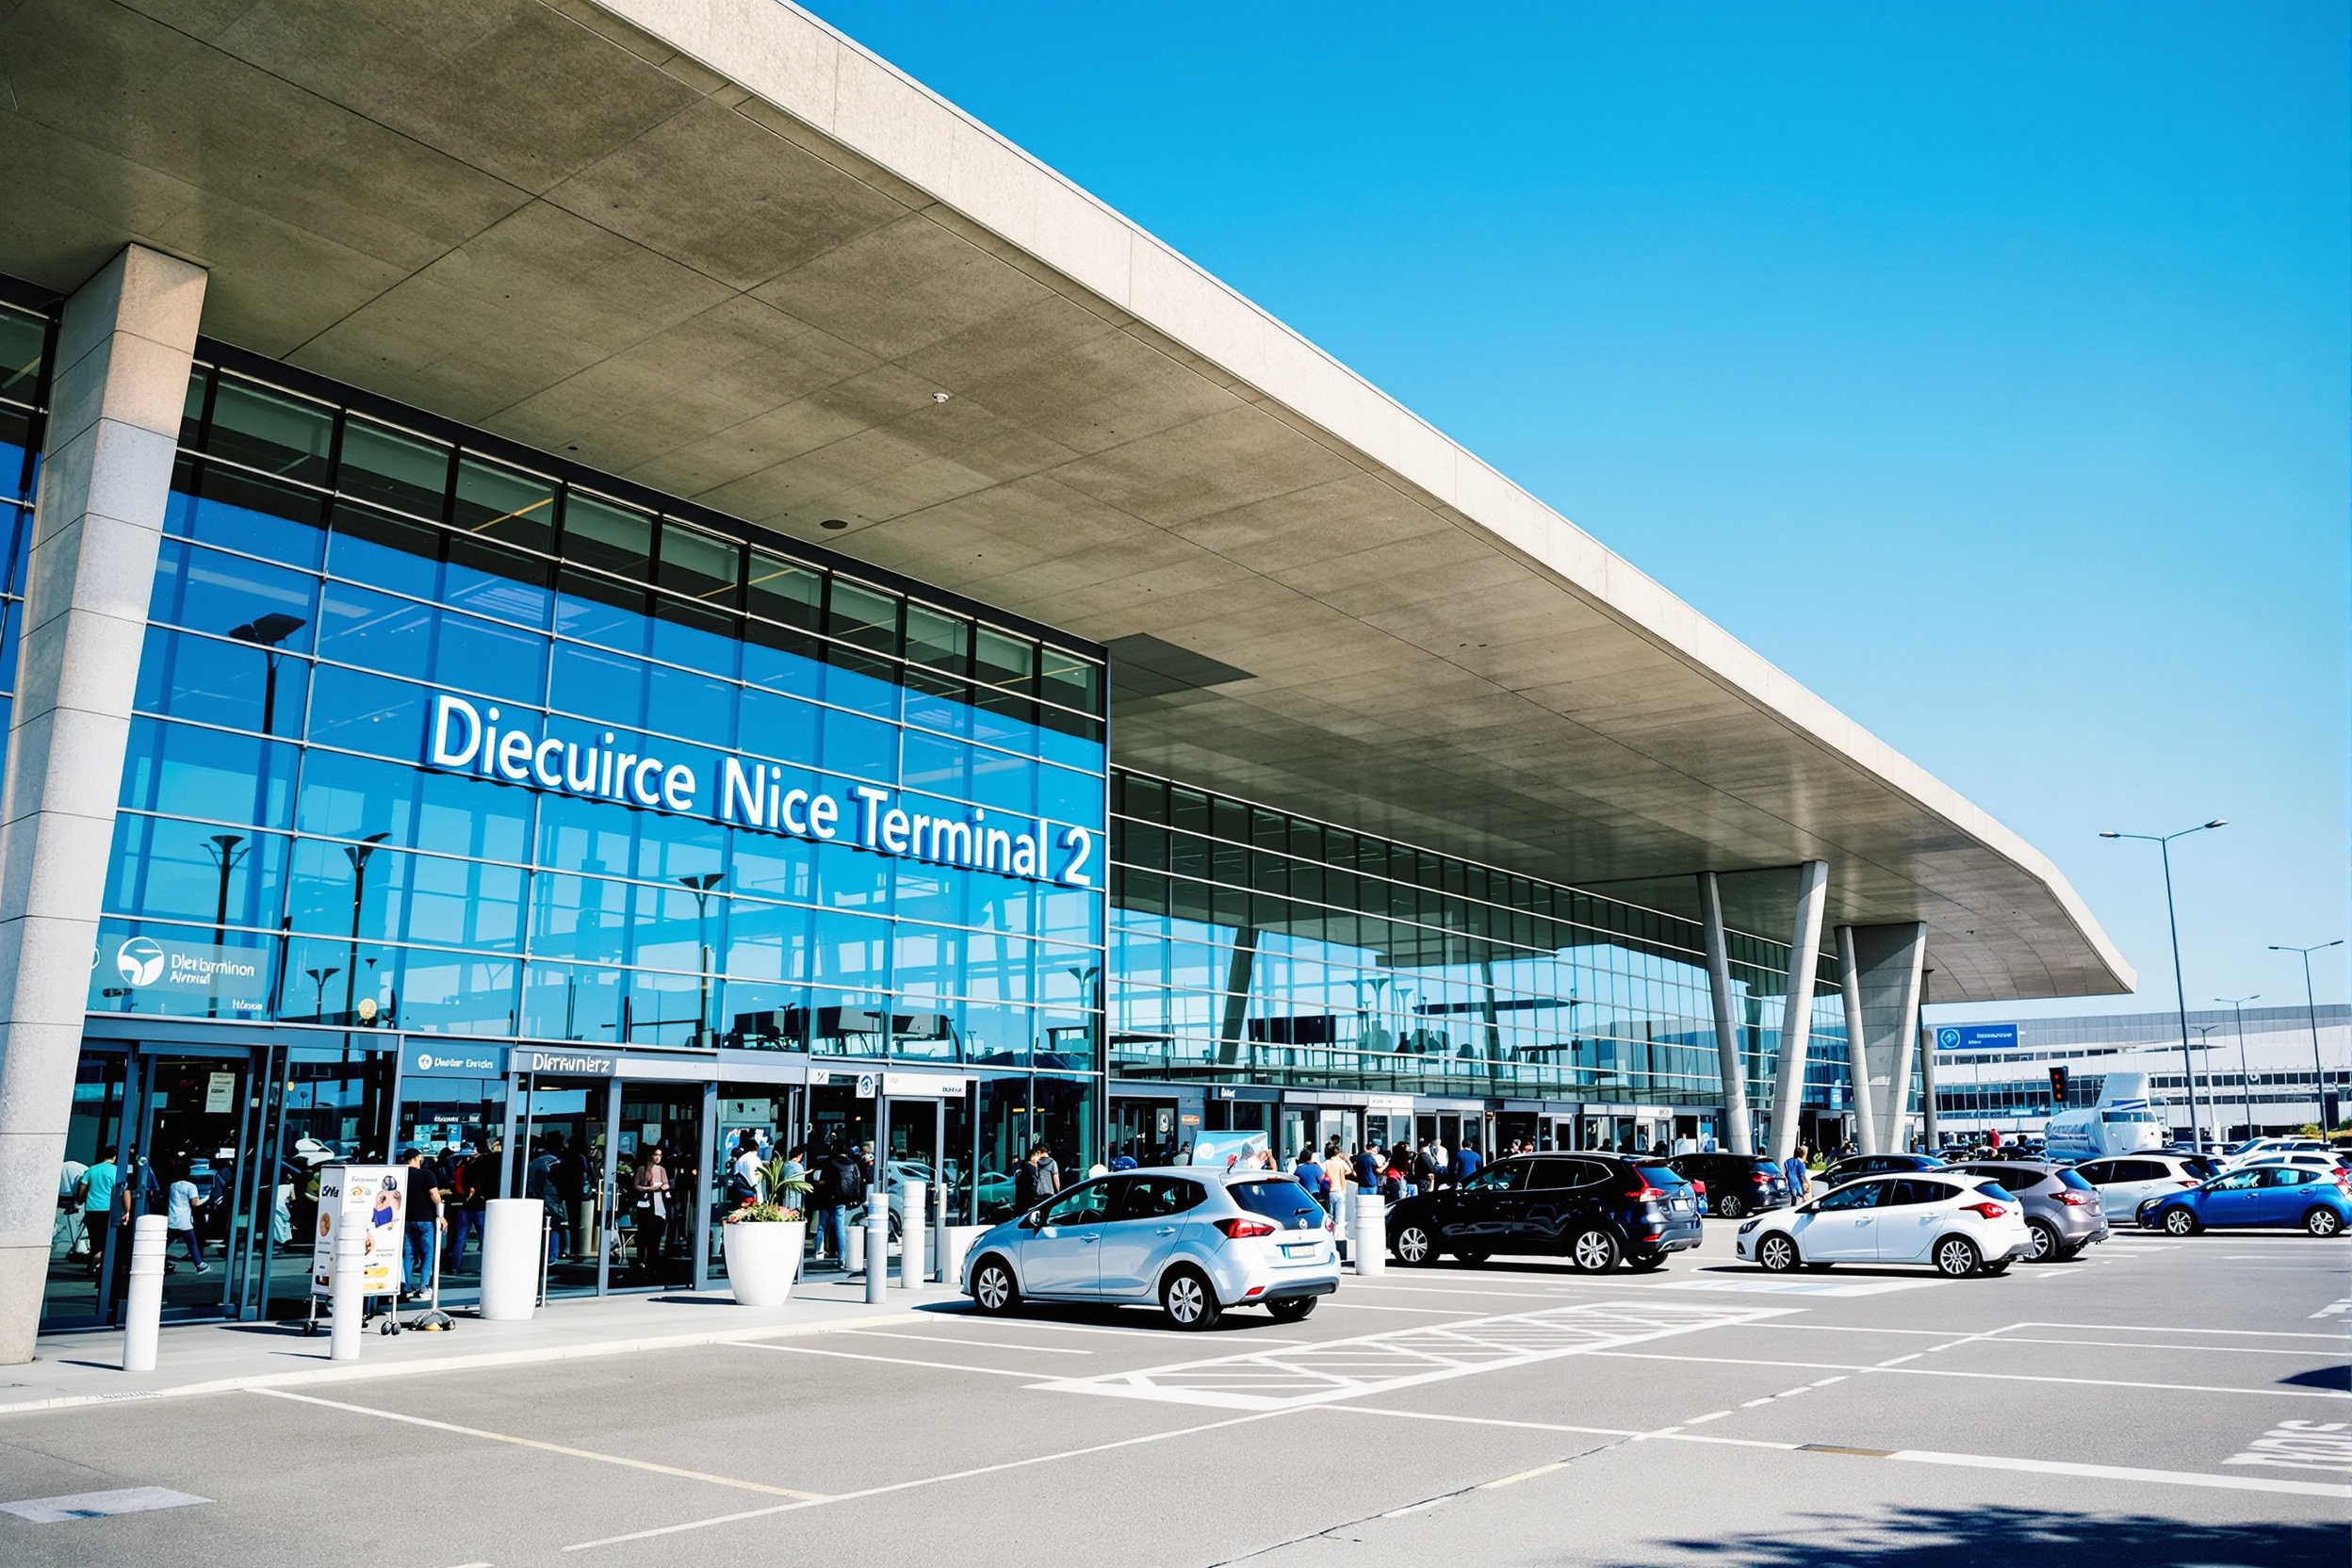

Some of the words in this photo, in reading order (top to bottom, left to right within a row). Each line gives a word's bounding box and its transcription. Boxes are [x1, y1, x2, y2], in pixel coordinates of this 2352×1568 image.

[430, 694, 696, 810] Diecuirce
[720, 757, 839, 840] Nice
[857, 785, 1049, 878] Terminal
[1062, 826, 1092, 887] 2
